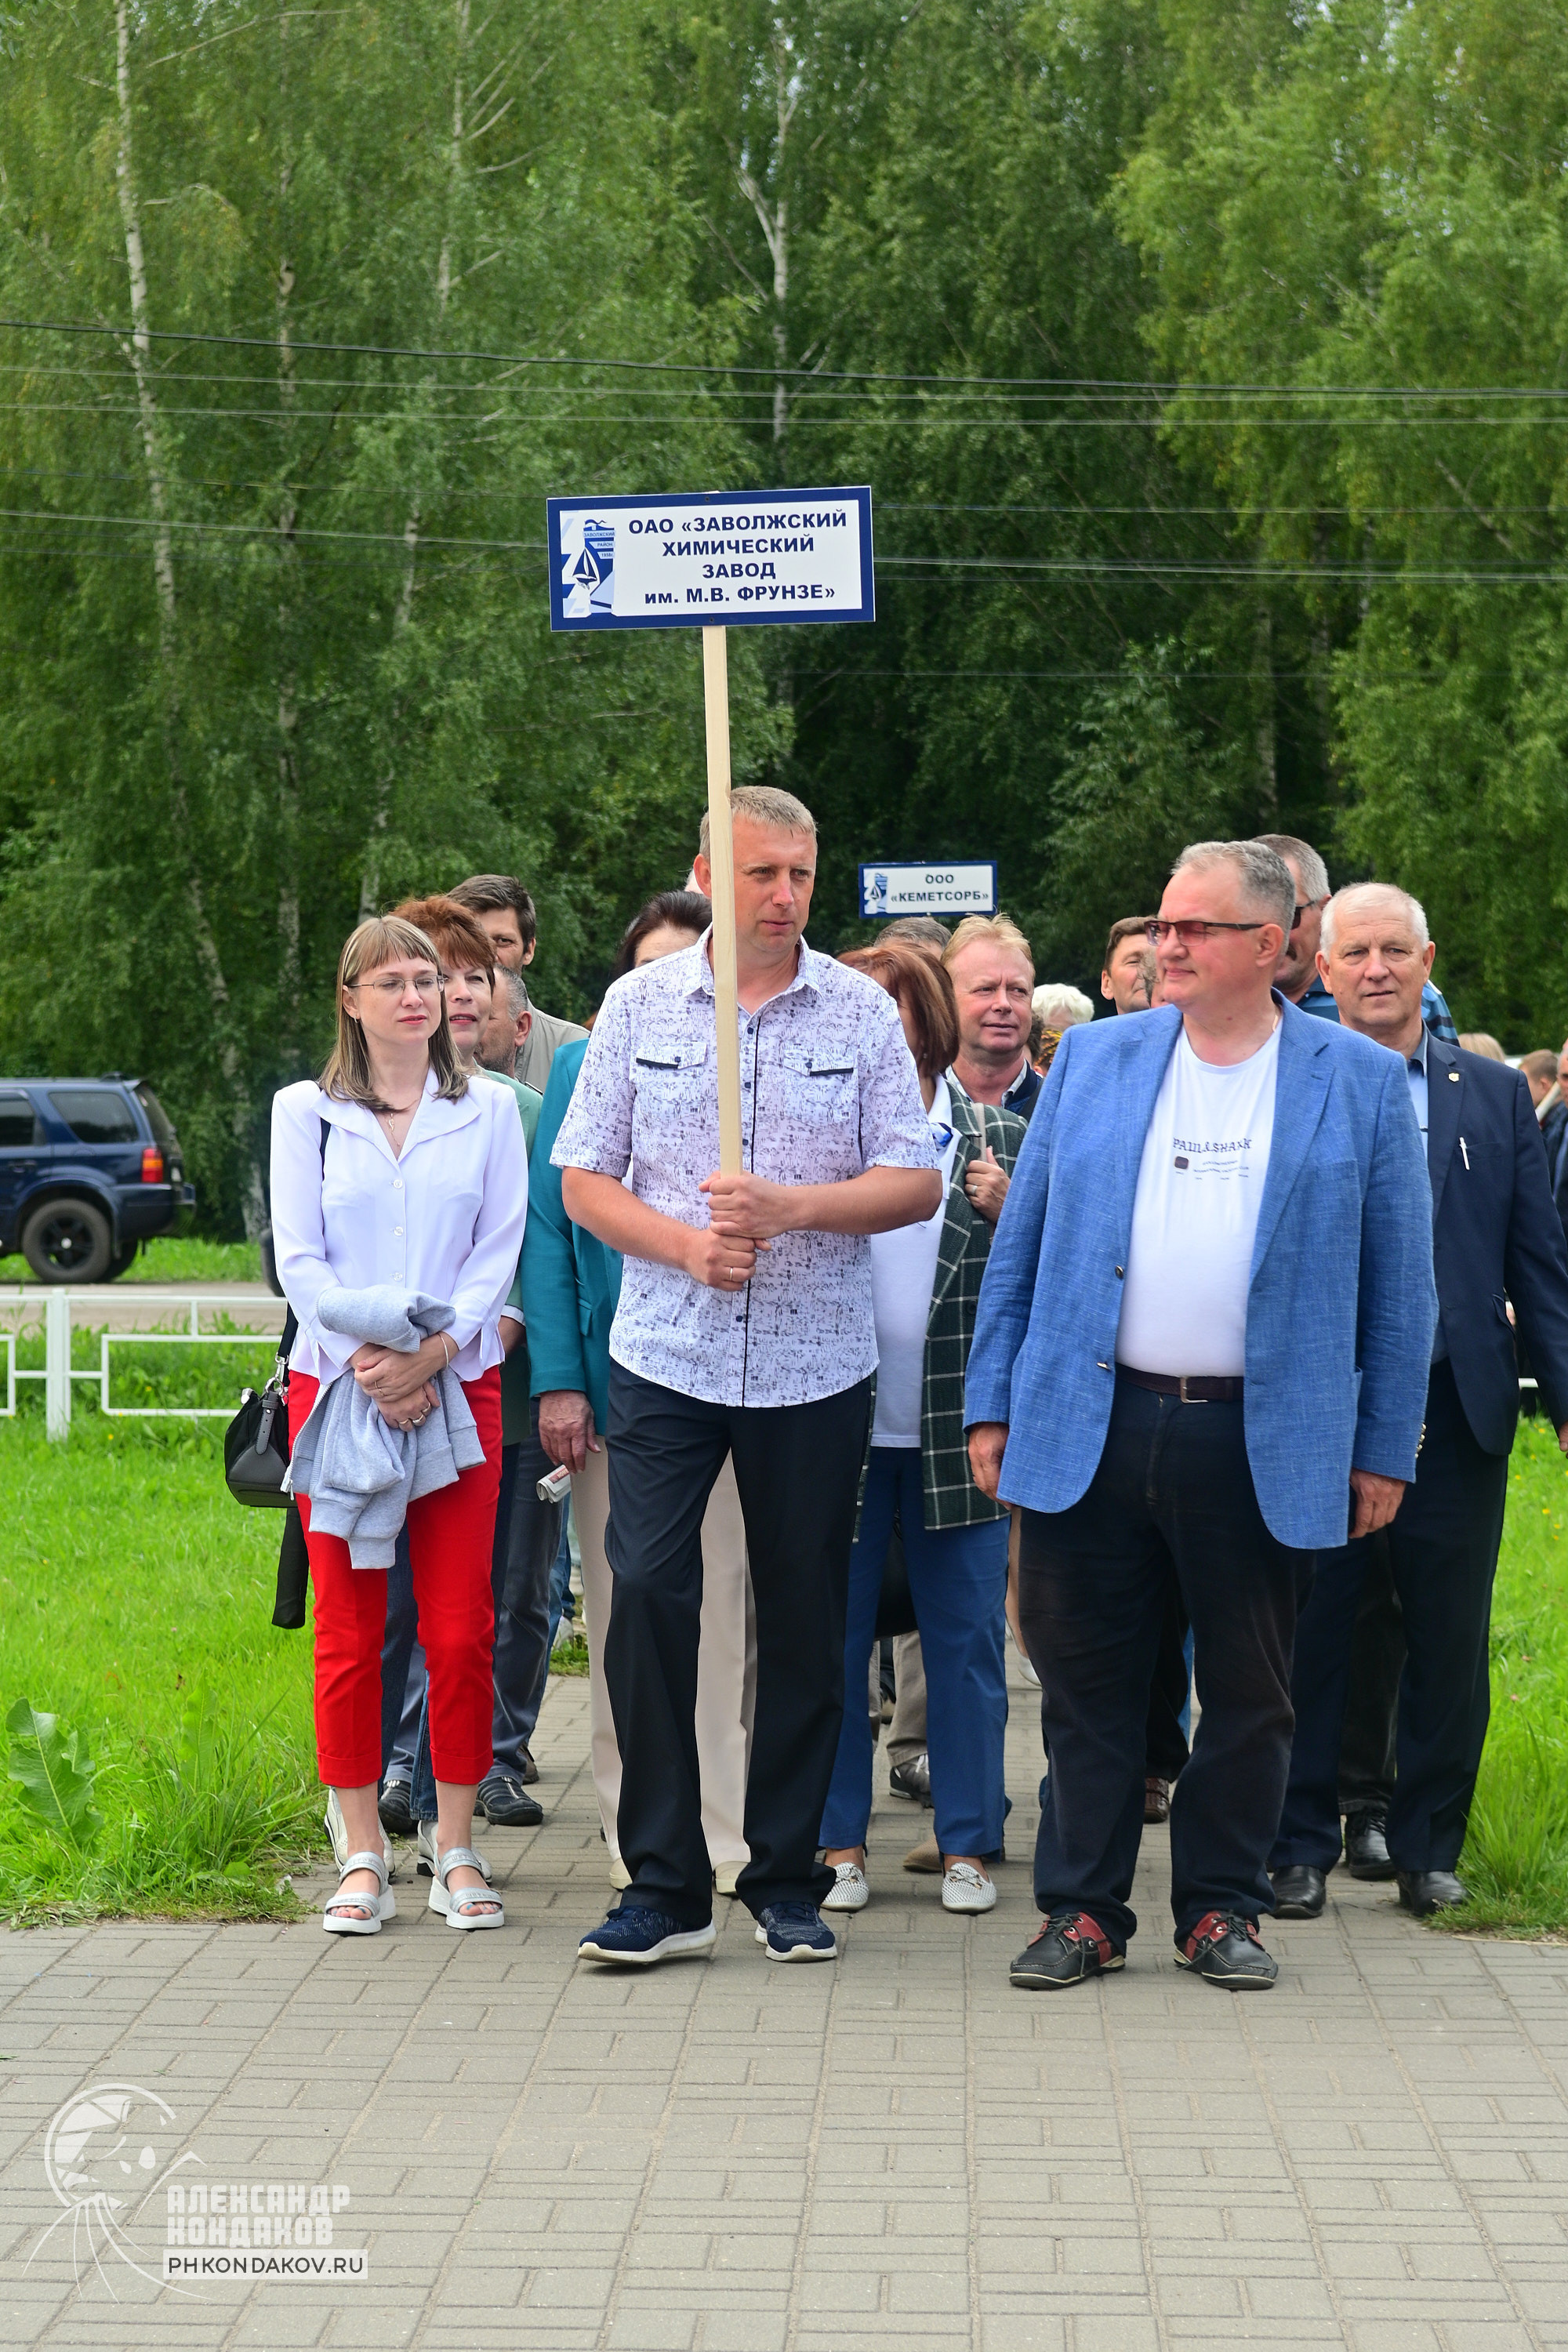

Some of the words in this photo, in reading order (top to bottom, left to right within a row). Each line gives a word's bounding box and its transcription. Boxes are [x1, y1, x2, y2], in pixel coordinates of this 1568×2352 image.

[629, 518, 674, 535] ОАО
[681, 509, 847, 532] «ЗАВОЛЖСКИЙ
[662, 533, 814, 557] ХИМИЧЕСКИЙ
[702, 562, 776, 580] ЗАВОД
[644, 593, 679, 604] им.
[686, 587, 730, 603] М.В.
[737, 584, 835, 601] ФРУНЗЕ»
[925, 874, 954, 884] ООО
[891, 891, 989, 902] «КЕМЕТСОРБ»
